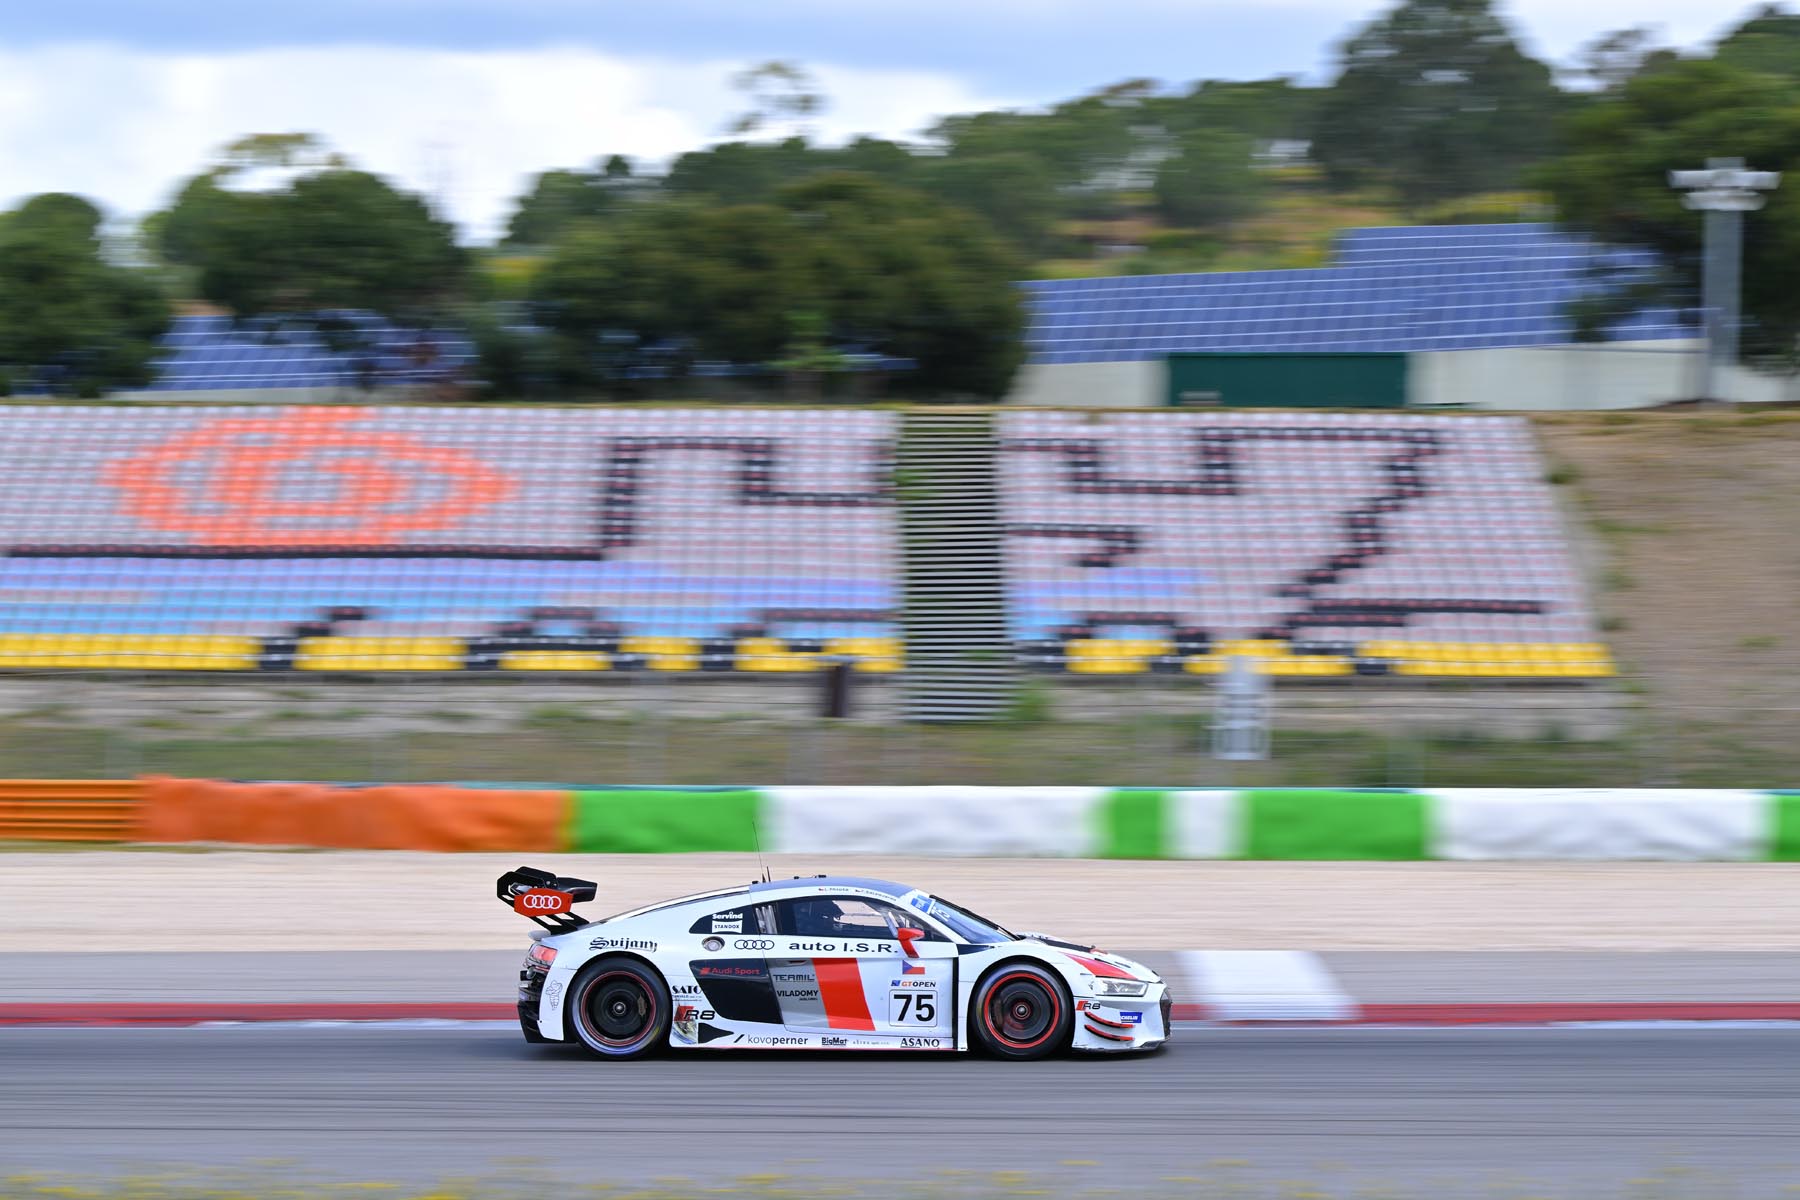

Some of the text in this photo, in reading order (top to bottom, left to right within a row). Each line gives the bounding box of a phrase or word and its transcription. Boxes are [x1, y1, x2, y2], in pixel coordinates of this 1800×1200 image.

[789, 942, 898, 953] auto I.S.R.
[735, 967, 760, 975] Sport
[893, 994, 935, 1022] 75
[1083, 1002, 1101, 1010] R8
[683, 1009, 716, 1020] R8
[901, 1037, 940, 1048] ASANO
